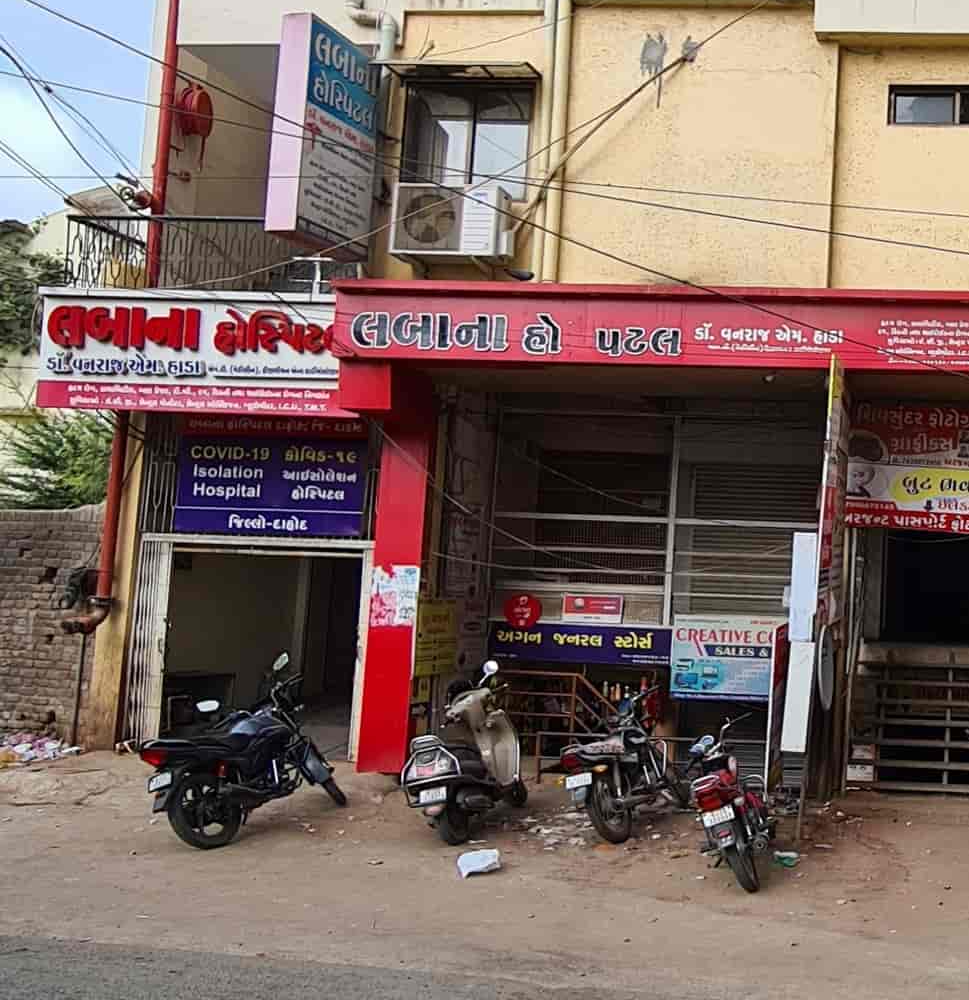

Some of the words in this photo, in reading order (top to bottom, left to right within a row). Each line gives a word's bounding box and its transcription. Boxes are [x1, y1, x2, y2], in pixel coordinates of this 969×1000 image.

[46, 305, 201, 352] લબાના
[351, 311, 508, 352] લબાના
[522, 313, 563, 354] હો
[596, 327, 682, 357] પટલ
[191, 446, 271, 461] COVID-19
[193, 464, 264, 480] Isolation
[193, 482, 262, 500] Hospital
[553, 632, 602, 647] જનરલ
[675, 628, 751, 650] CREATIVE
[714, 646, 755, 658] SALES
